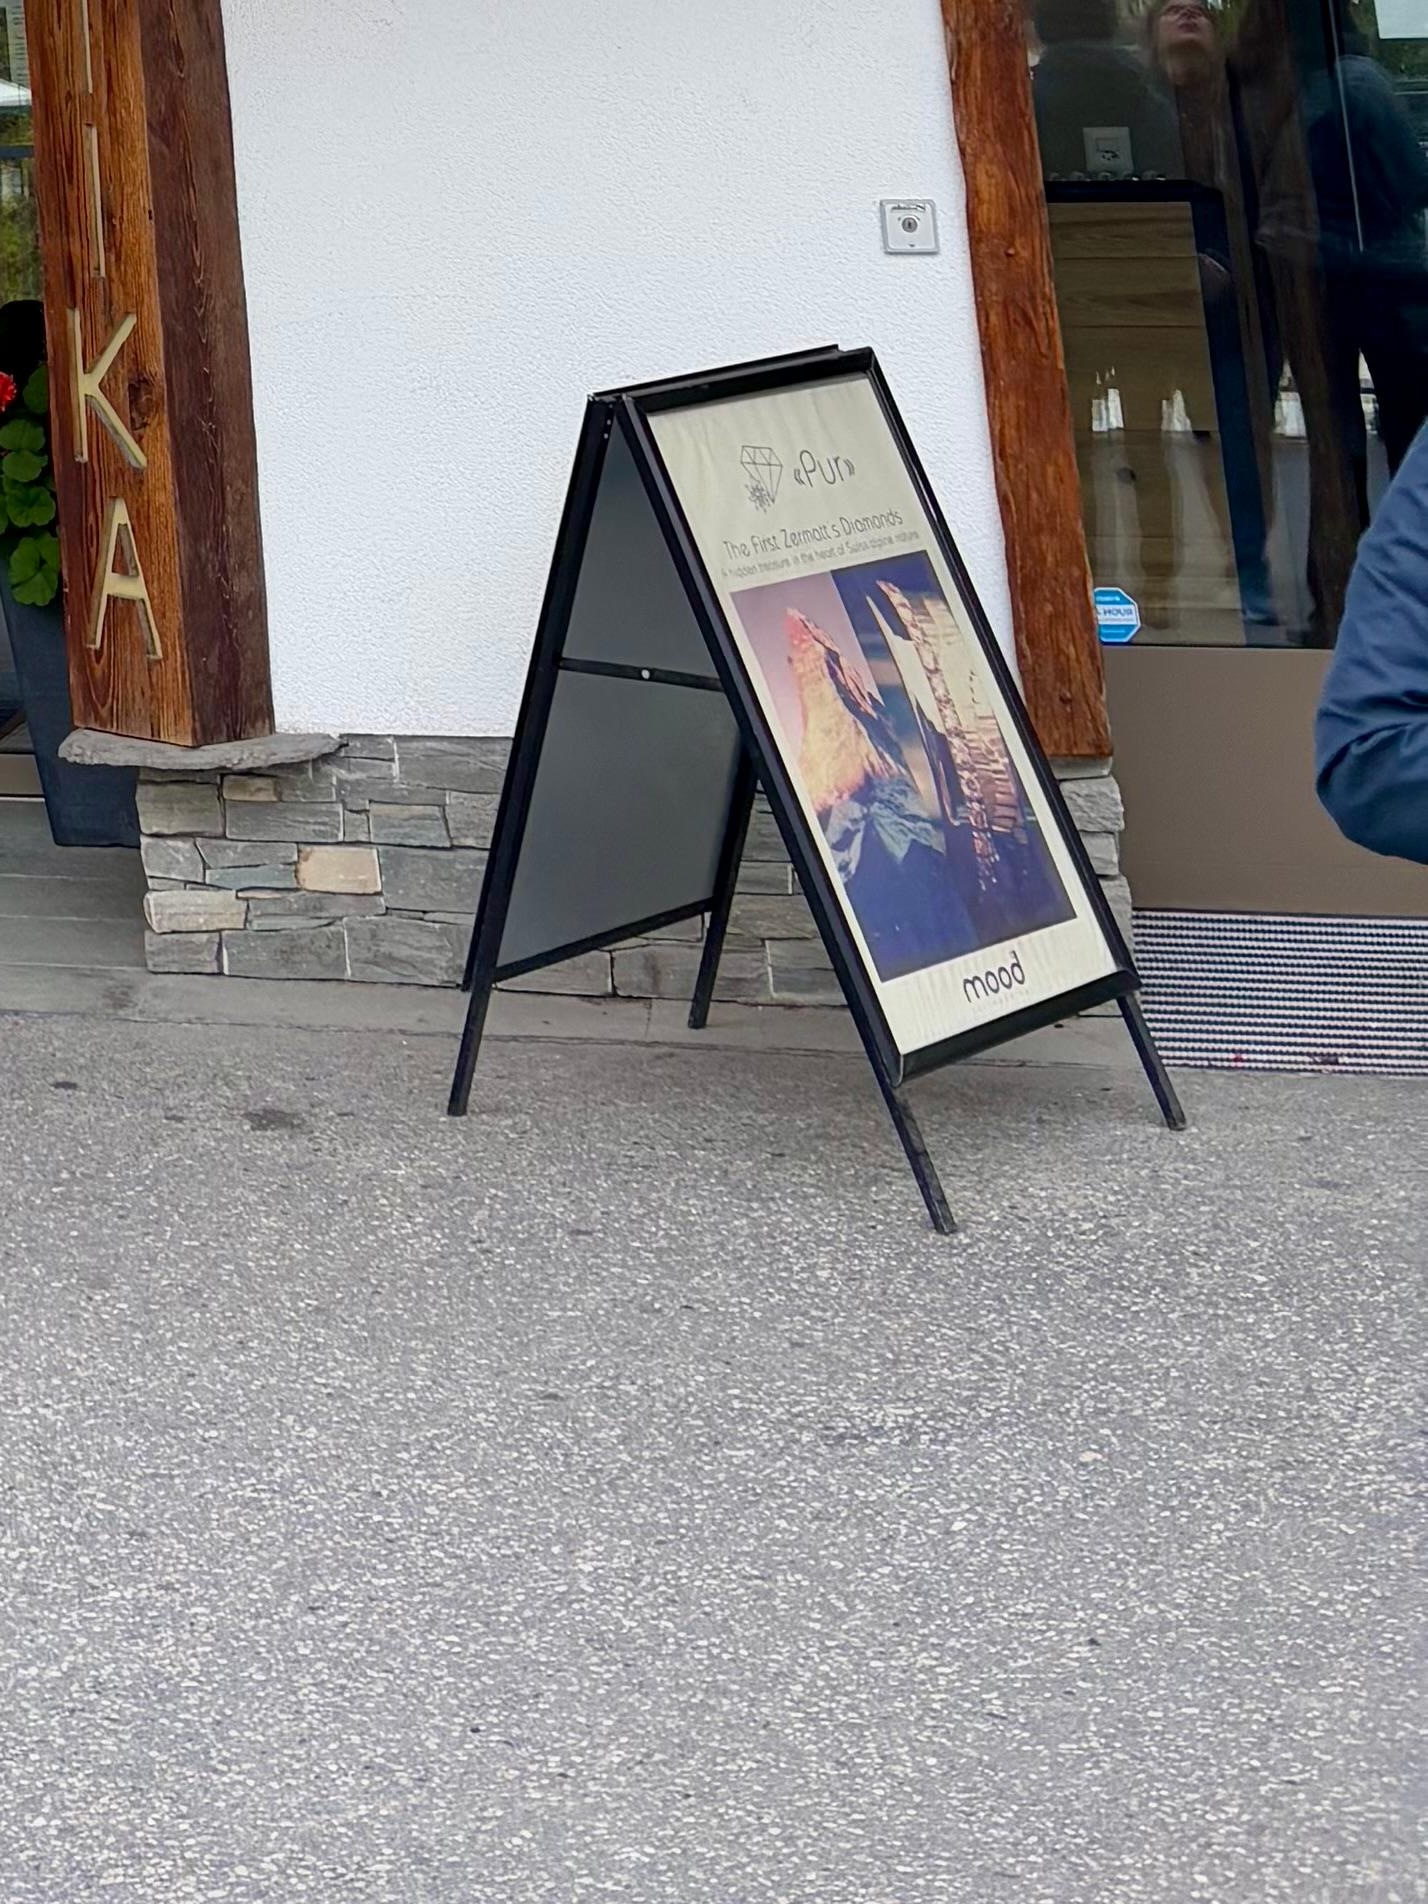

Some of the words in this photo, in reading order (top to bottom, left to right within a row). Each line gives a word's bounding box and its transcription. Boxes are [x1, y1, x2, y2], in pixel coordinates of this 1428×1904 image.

[723, 540, 750, 560] The
[750, 535, 781, 554] First
[840, 507, 903, 536] Diamonds
[962, 949, 1026, 1003] mood
